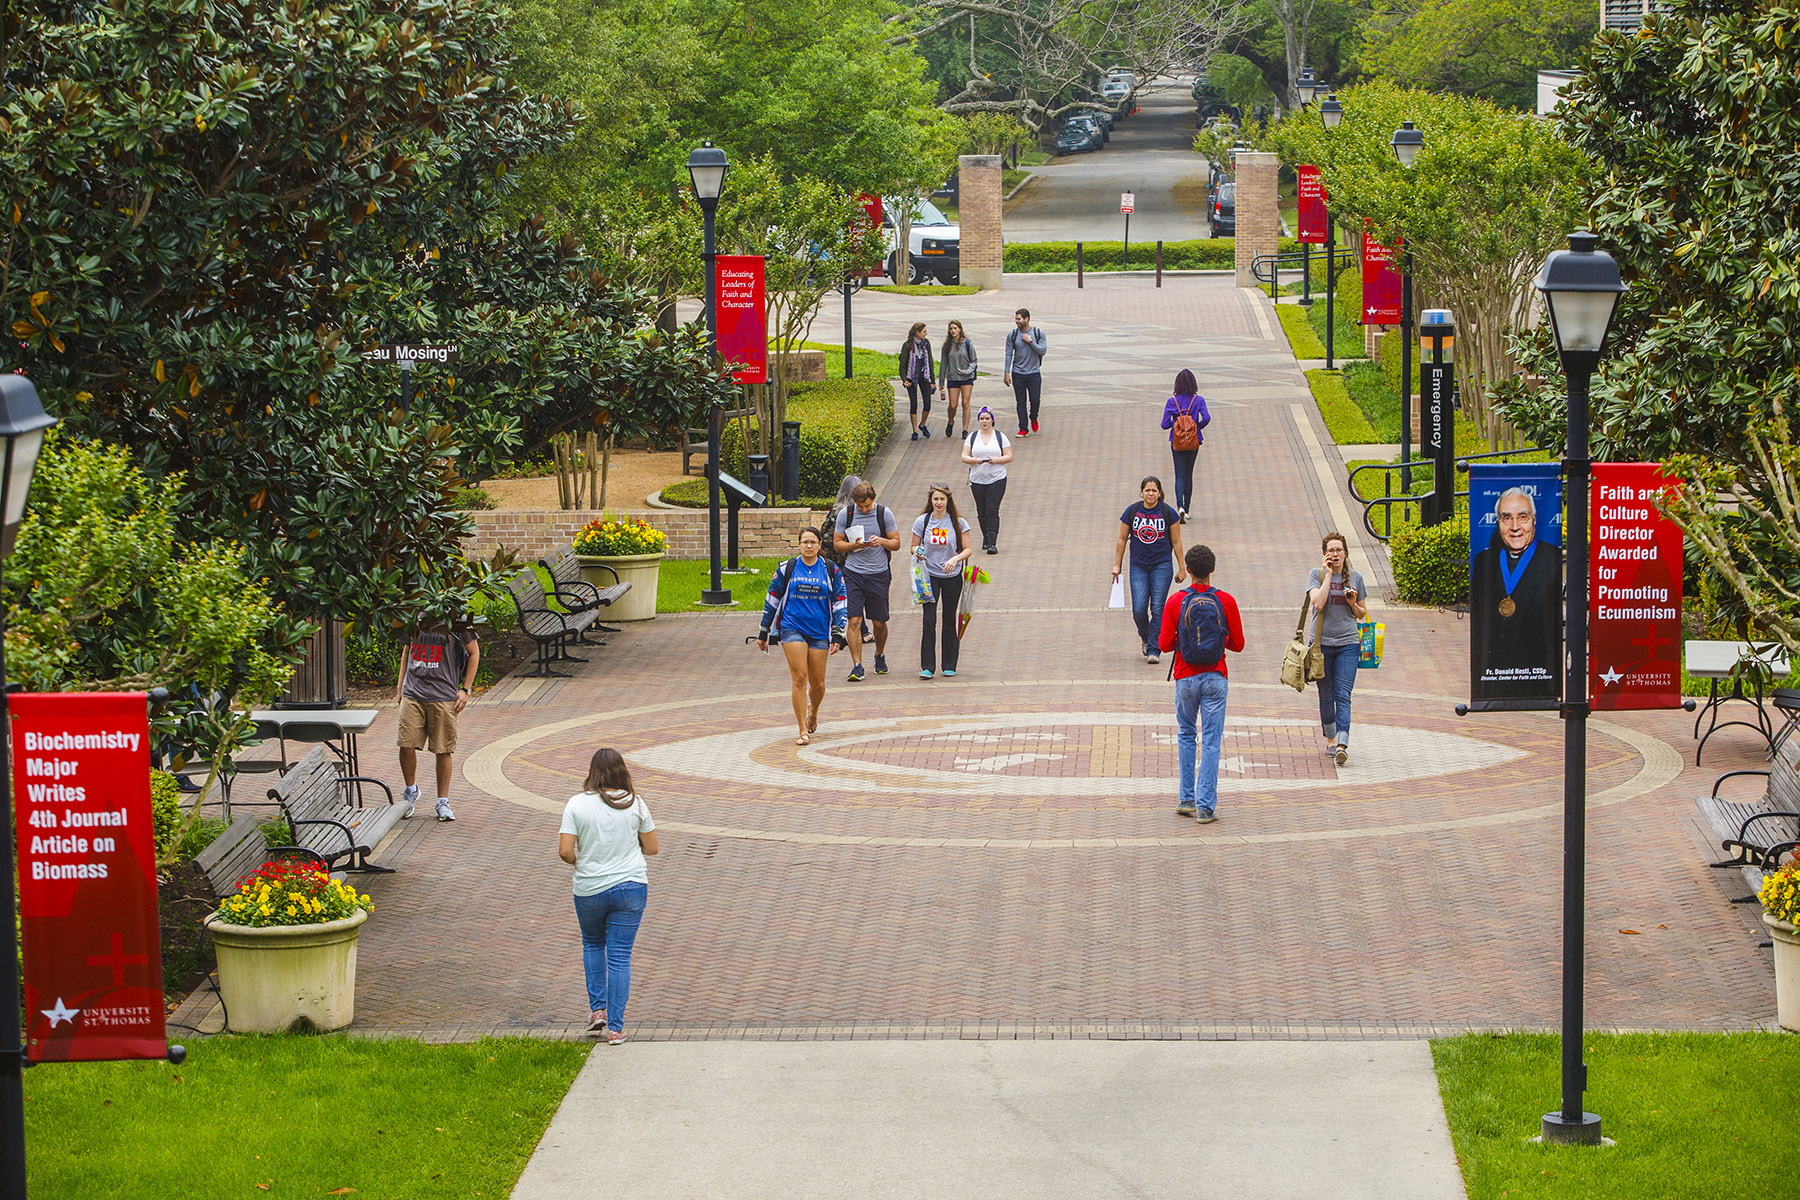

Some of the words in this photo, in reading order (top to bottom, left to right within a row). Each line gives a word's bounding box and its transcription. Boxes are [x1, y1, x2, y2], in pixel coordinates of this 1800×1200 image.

[722, 270, 754, 279] Educating
[748, 280, 755, 289] of
[721, 300, 754, 308] Character
[362, 349, 390, 360] eau
[395, 345, 447, 362] Mosing
[1430, 369, 1442, 448] Emergency
[1520, 485, 1542, 496] DL
[1600, 486, 1634, 500] Faith
[1638, 486, 1663, 500] and
[1478, 513, 1497, 524] AD
[1600, 506, 1648, 520] Culture
[1133, 516, 1166, 530] BAND
[1600, 526, 1654, 540] Director
[1598, 546, 1657, 560] Awarded
[1598, 566, 1617, 580] for
[1599, 586, 1668, 602] Promoting
[1598, 606, 1676, 620] Ecumenism
[25, 731, 140, 752] Biochemistry
[26, 757, 78, 780] Major
[27, 784, 86, 802] Writes
[29, 810, 57, 828] 4th
[61, 808, 127, 828] Journal
[30, 835, 88, 854] Article
[93, 837, 115, 852] on
[32, 861, 108, 880] Biomass
[83, 1007, 150, 1016] UNIVERSITY
[105, 1017, 151, 1025] THOMAS
